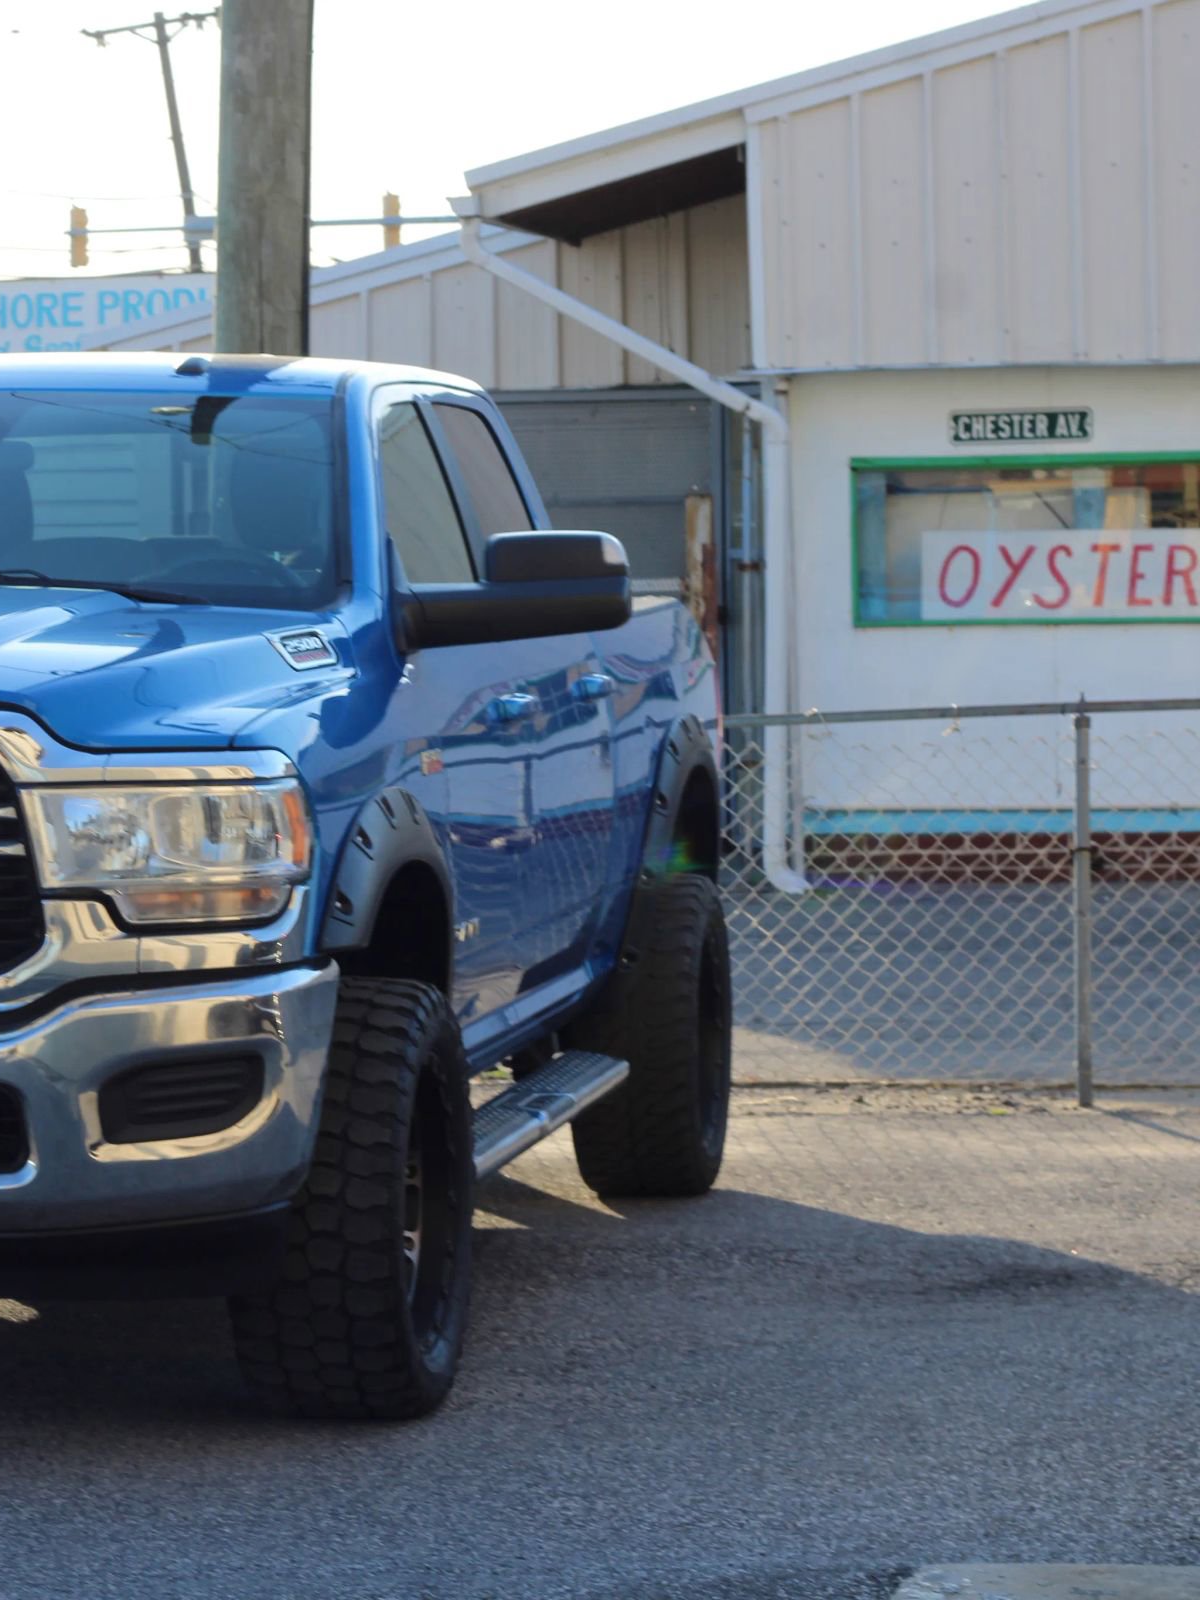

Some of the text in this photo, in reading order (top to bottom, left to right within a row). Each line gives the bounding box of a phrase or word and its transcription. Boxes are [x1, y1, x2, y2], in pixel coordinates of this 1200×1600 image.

[97, 287, 206, 326] PROD
[957, 413, 1049, 440] CHESTER
[938, 543, 1199, 610] OYSTER
[283, 636, 323, 653] 2500
